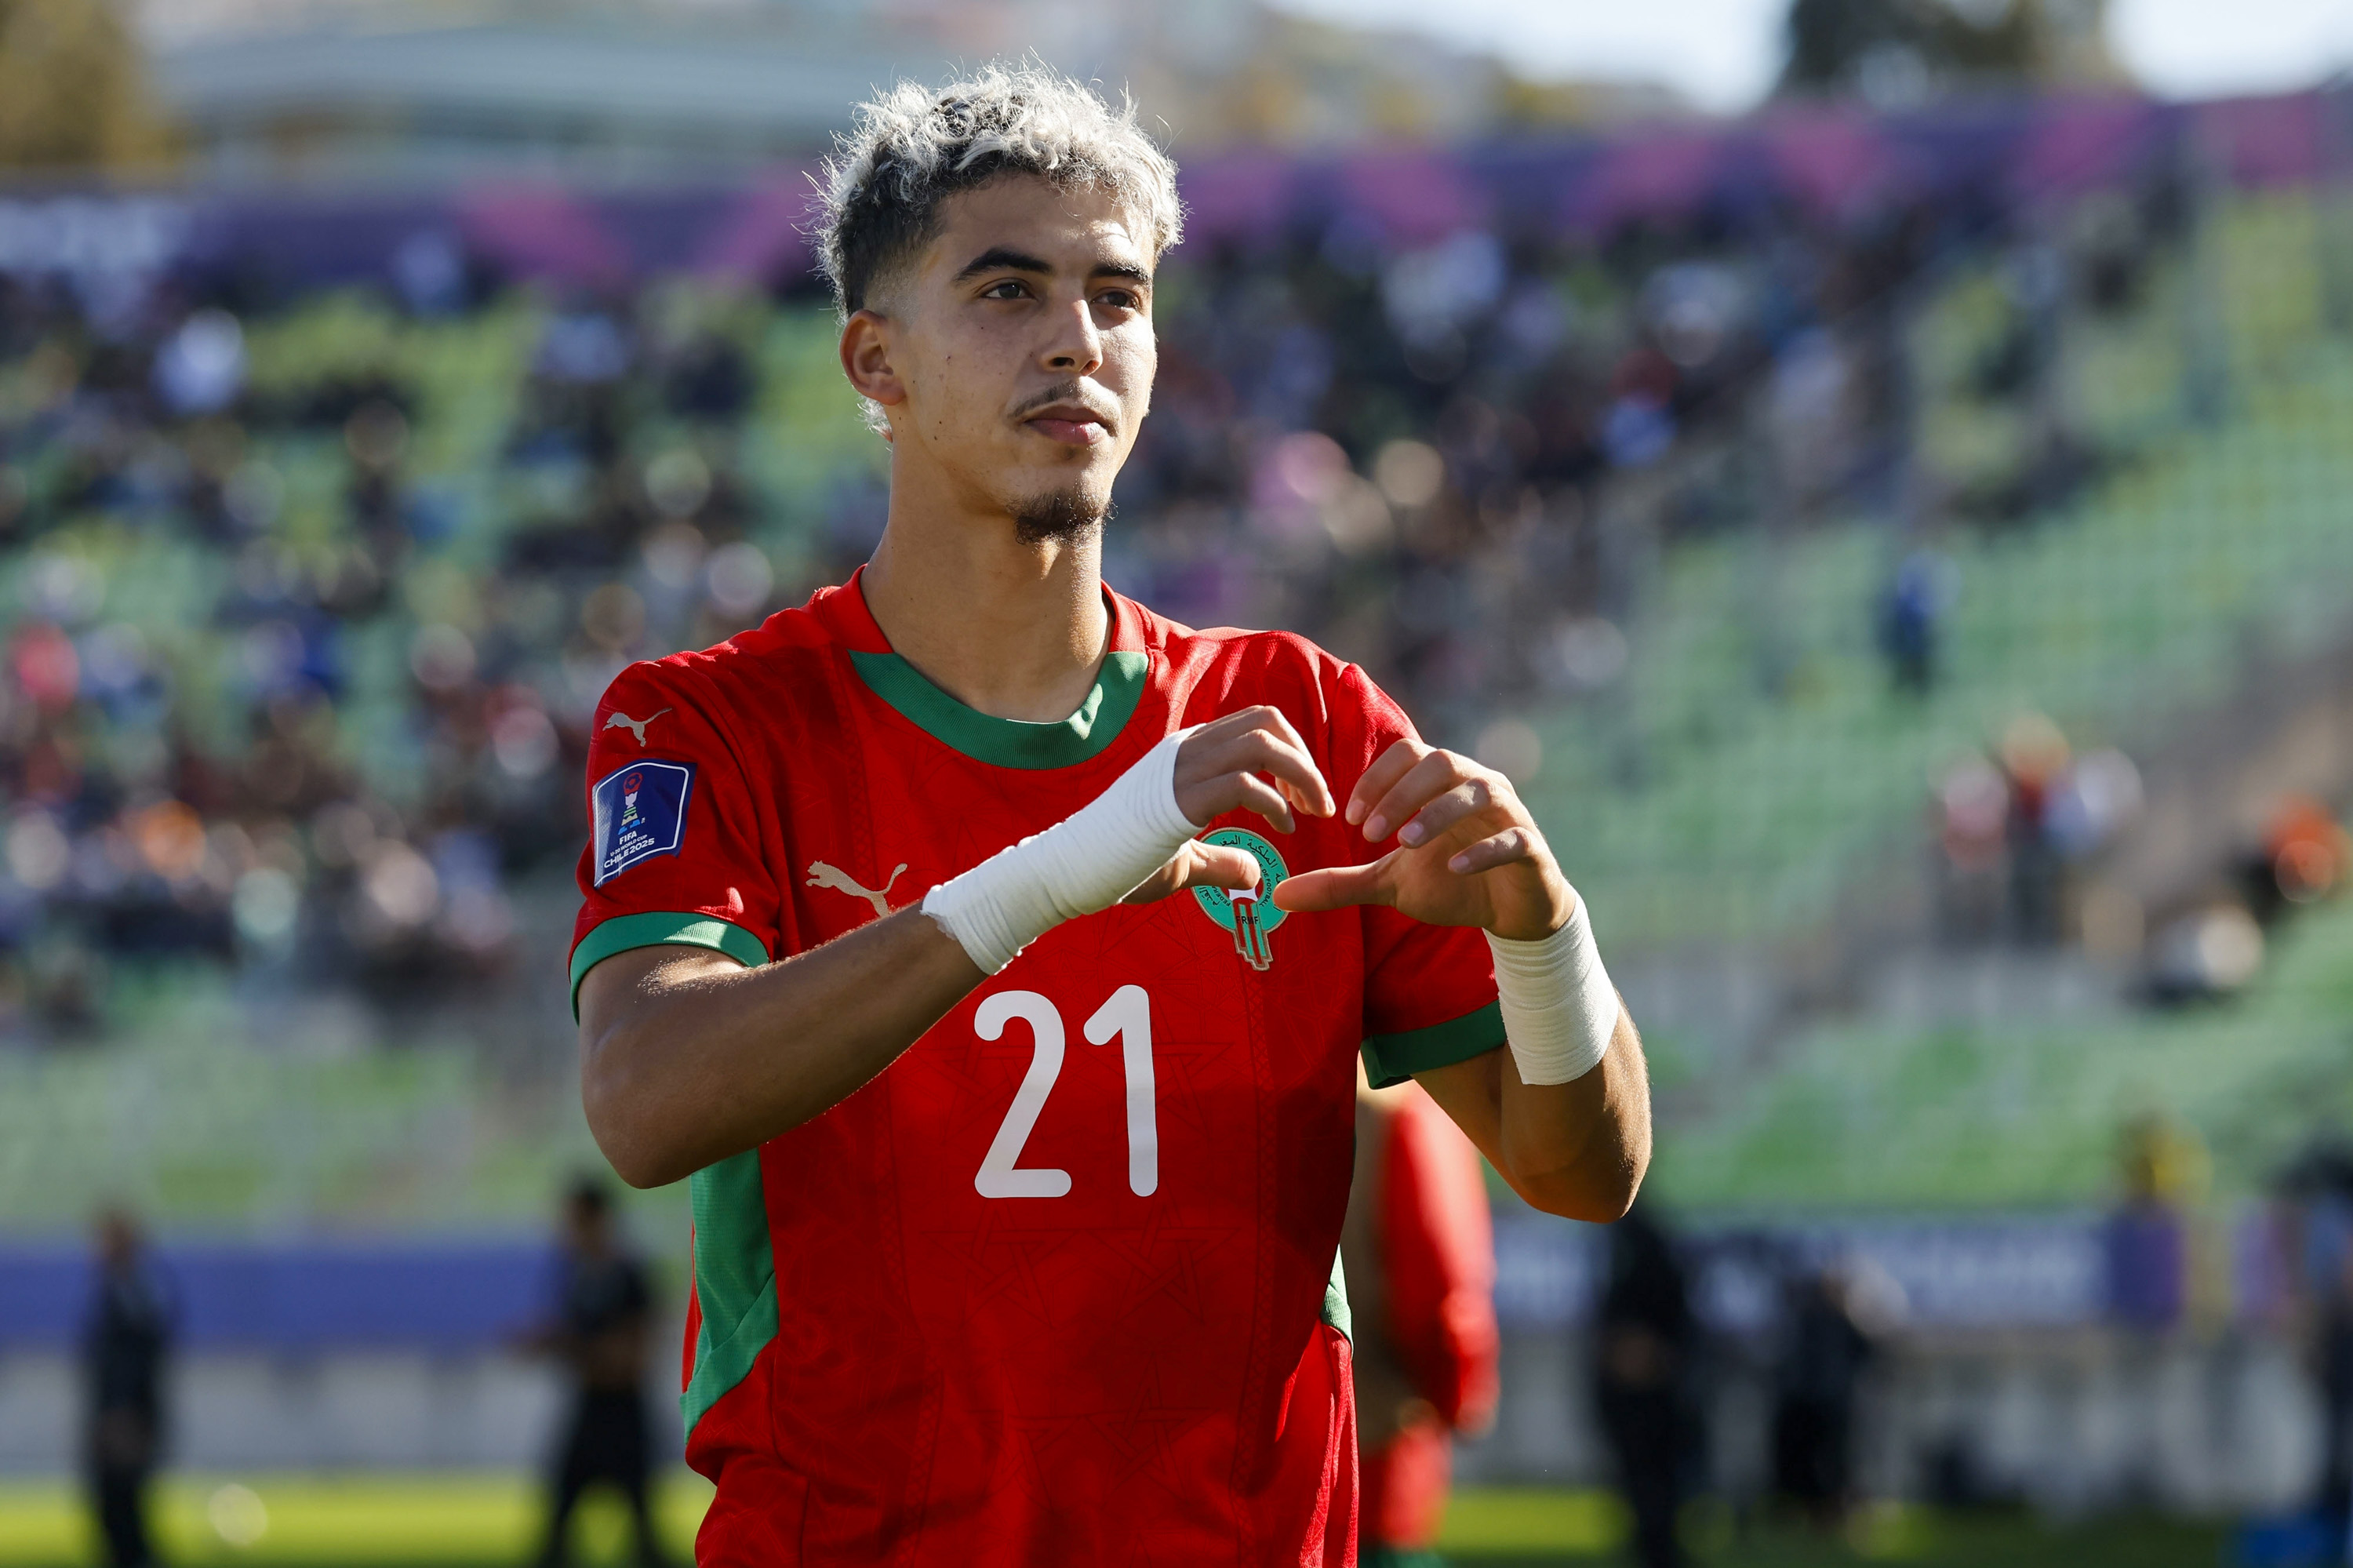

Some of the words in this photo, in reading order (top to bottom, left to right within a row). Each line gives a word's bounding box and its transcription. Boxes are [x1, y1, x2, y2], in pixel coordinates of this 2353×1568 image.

[620, 831, 637, 845] FIFA
[621, 839, 637, 851] WORLD
[604, 848, 629, 868] CHILE
[629, 838, 655, 854] 2025
[1247, 839, 1278, 868] الملكية
[1261, 868, 1270, 878] DE
[1259, 878, 1271, 907] FOOTBALL
[1235, 915, 1259, 925] FRMF
[974, 984, 1158, 1199] 21
